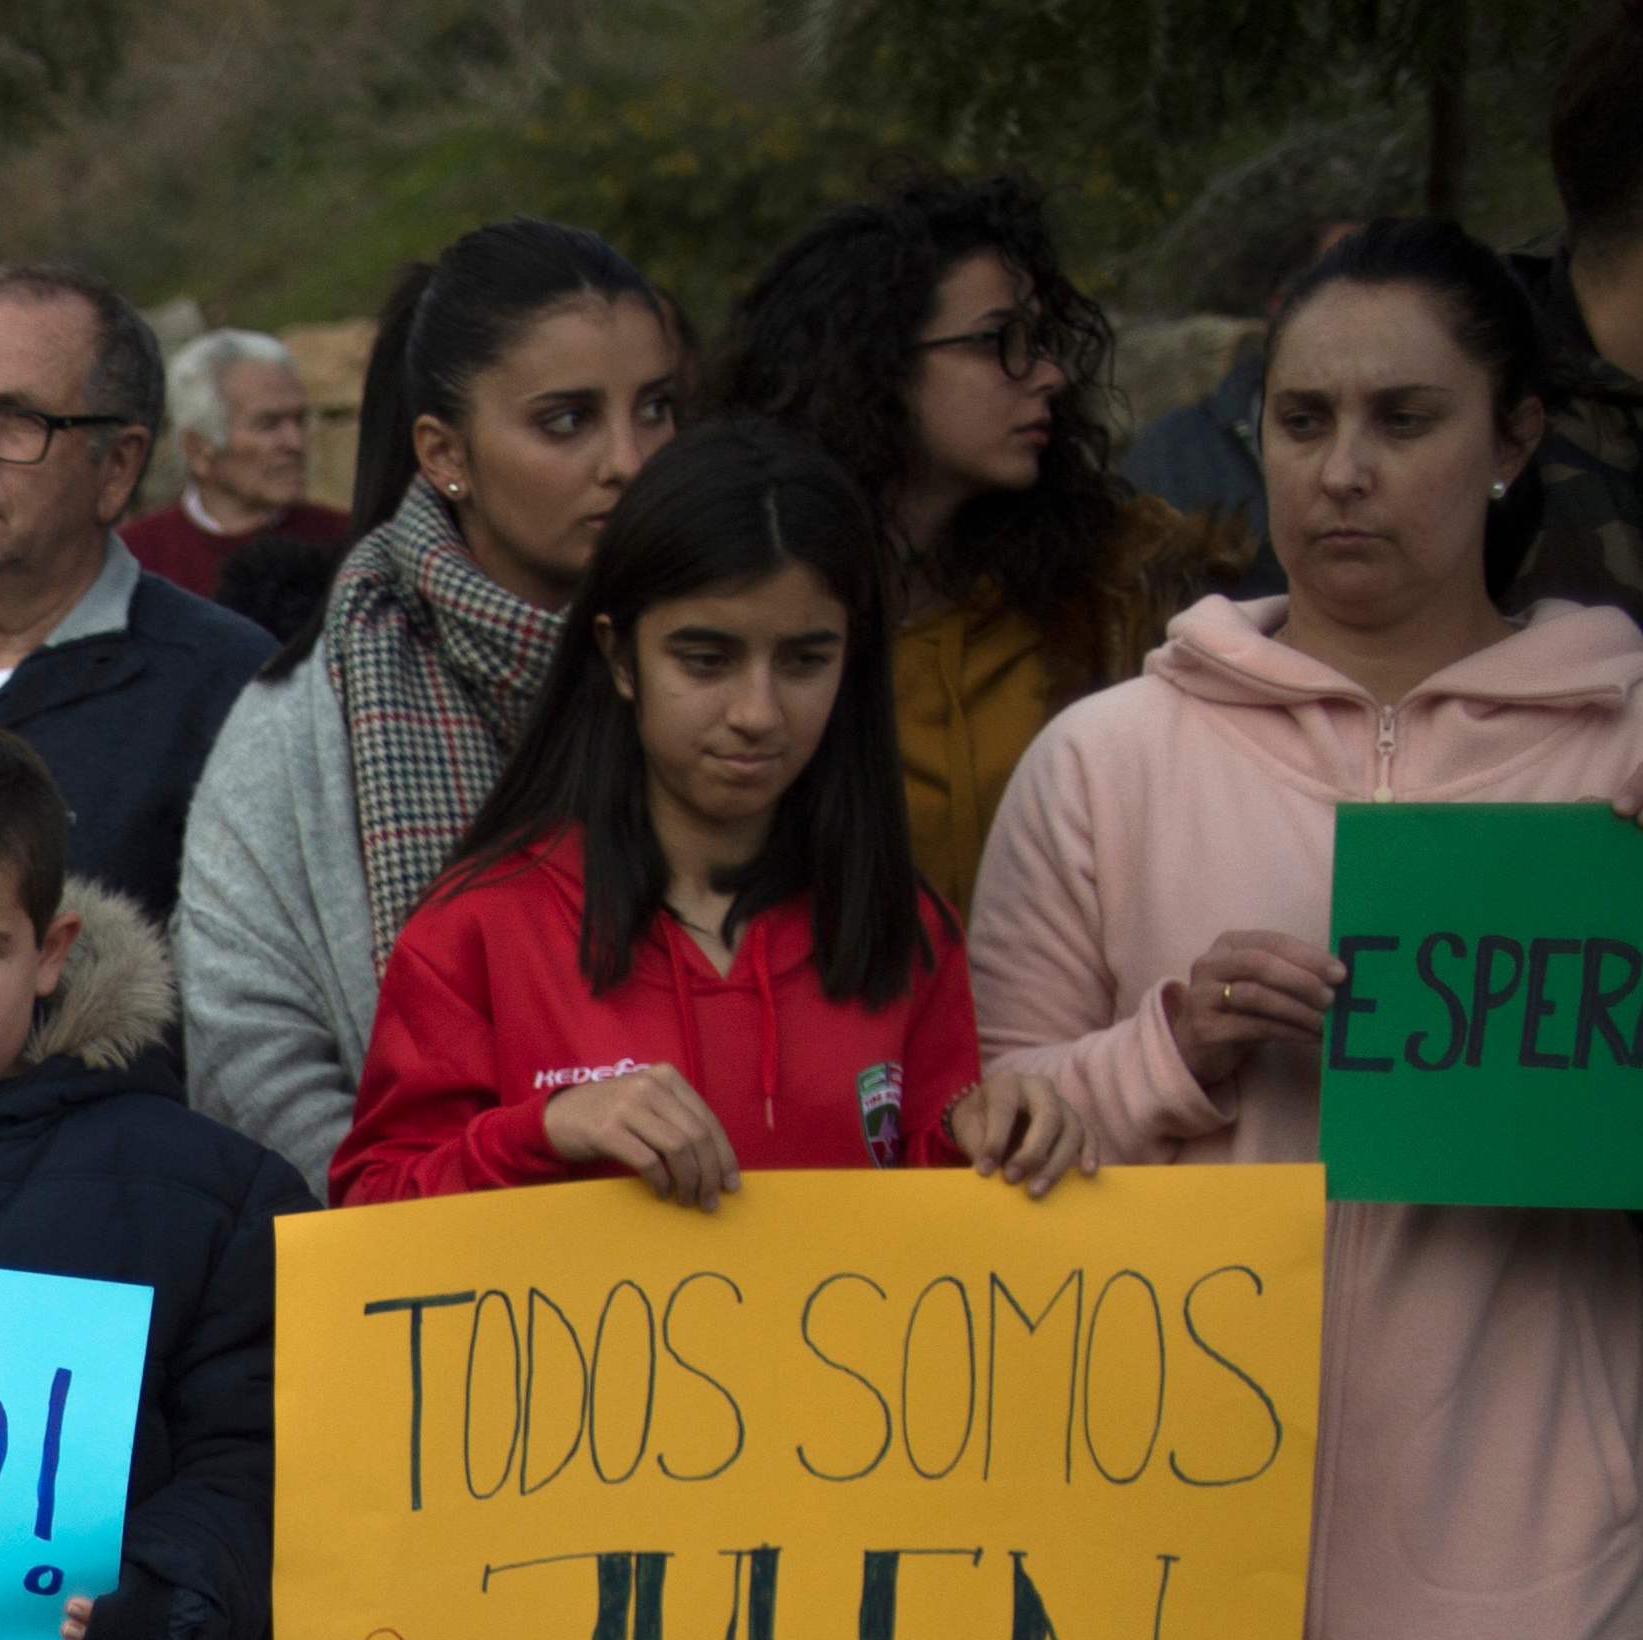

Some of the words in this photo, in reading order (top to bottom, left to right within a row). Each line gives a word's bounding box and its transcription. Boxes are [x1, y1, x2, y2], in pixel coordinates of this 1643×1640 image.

[1329, 932, 1643, 1073] ESPER
[364, 1272, 745, 1511] TODOS
[796, 1265, 1283, 1488] SOMOS
